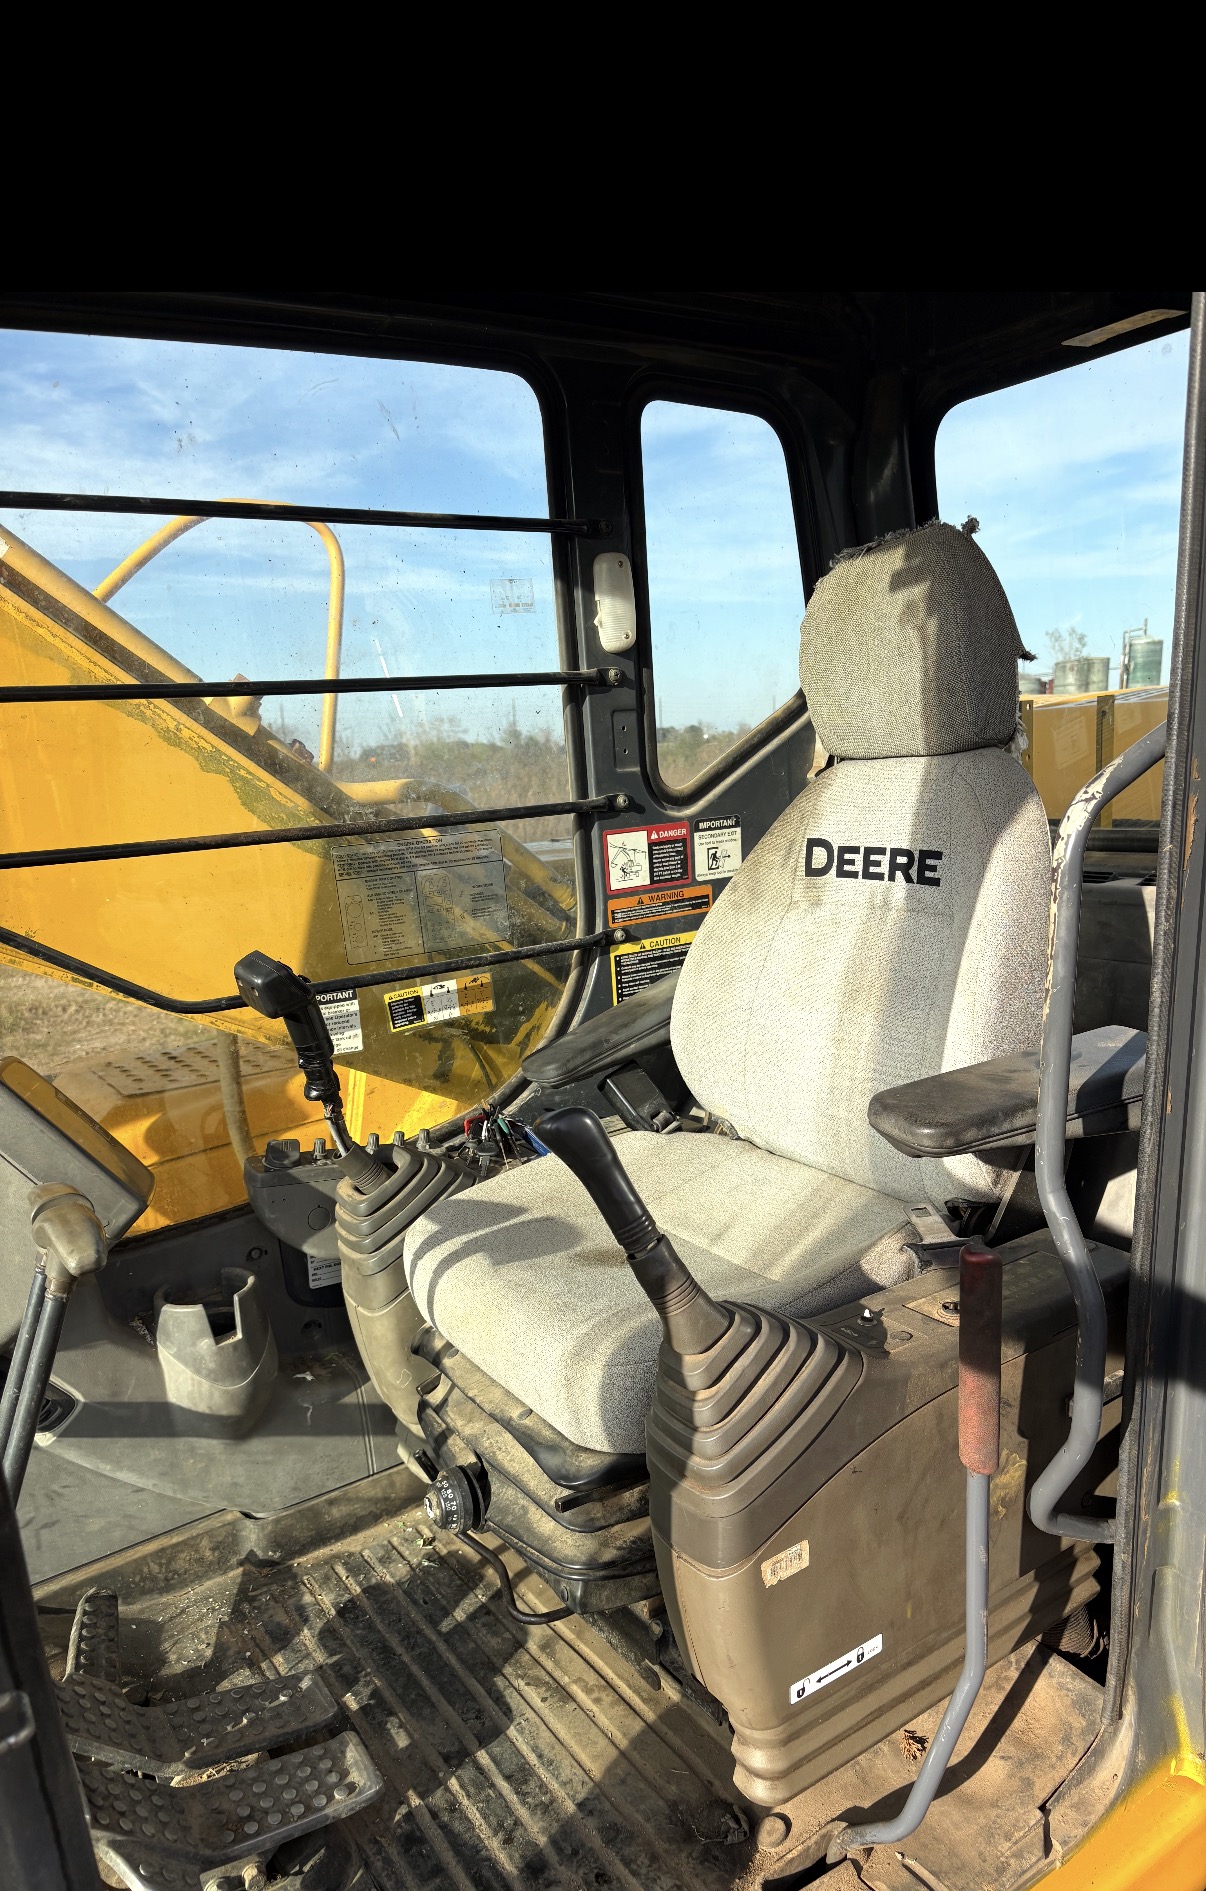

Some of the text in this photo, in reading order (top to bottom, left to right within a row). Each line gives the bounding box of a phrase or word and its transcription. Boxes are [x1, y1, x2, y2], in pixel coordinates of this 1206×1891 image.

[699, 818, 736, 830] IMPORTANT
[659, 828, 686, 838] DANGER
[698, 832, 727, 840] SECONDARY
[805, 837, 943, 887] DEERE
[648, 890, 685, 903] WARNING
[649, 937, 681, 948] CAUTION
[316, 990, 354, 1002] PORTANT
[393, 989, 419, 999] CAUTION
